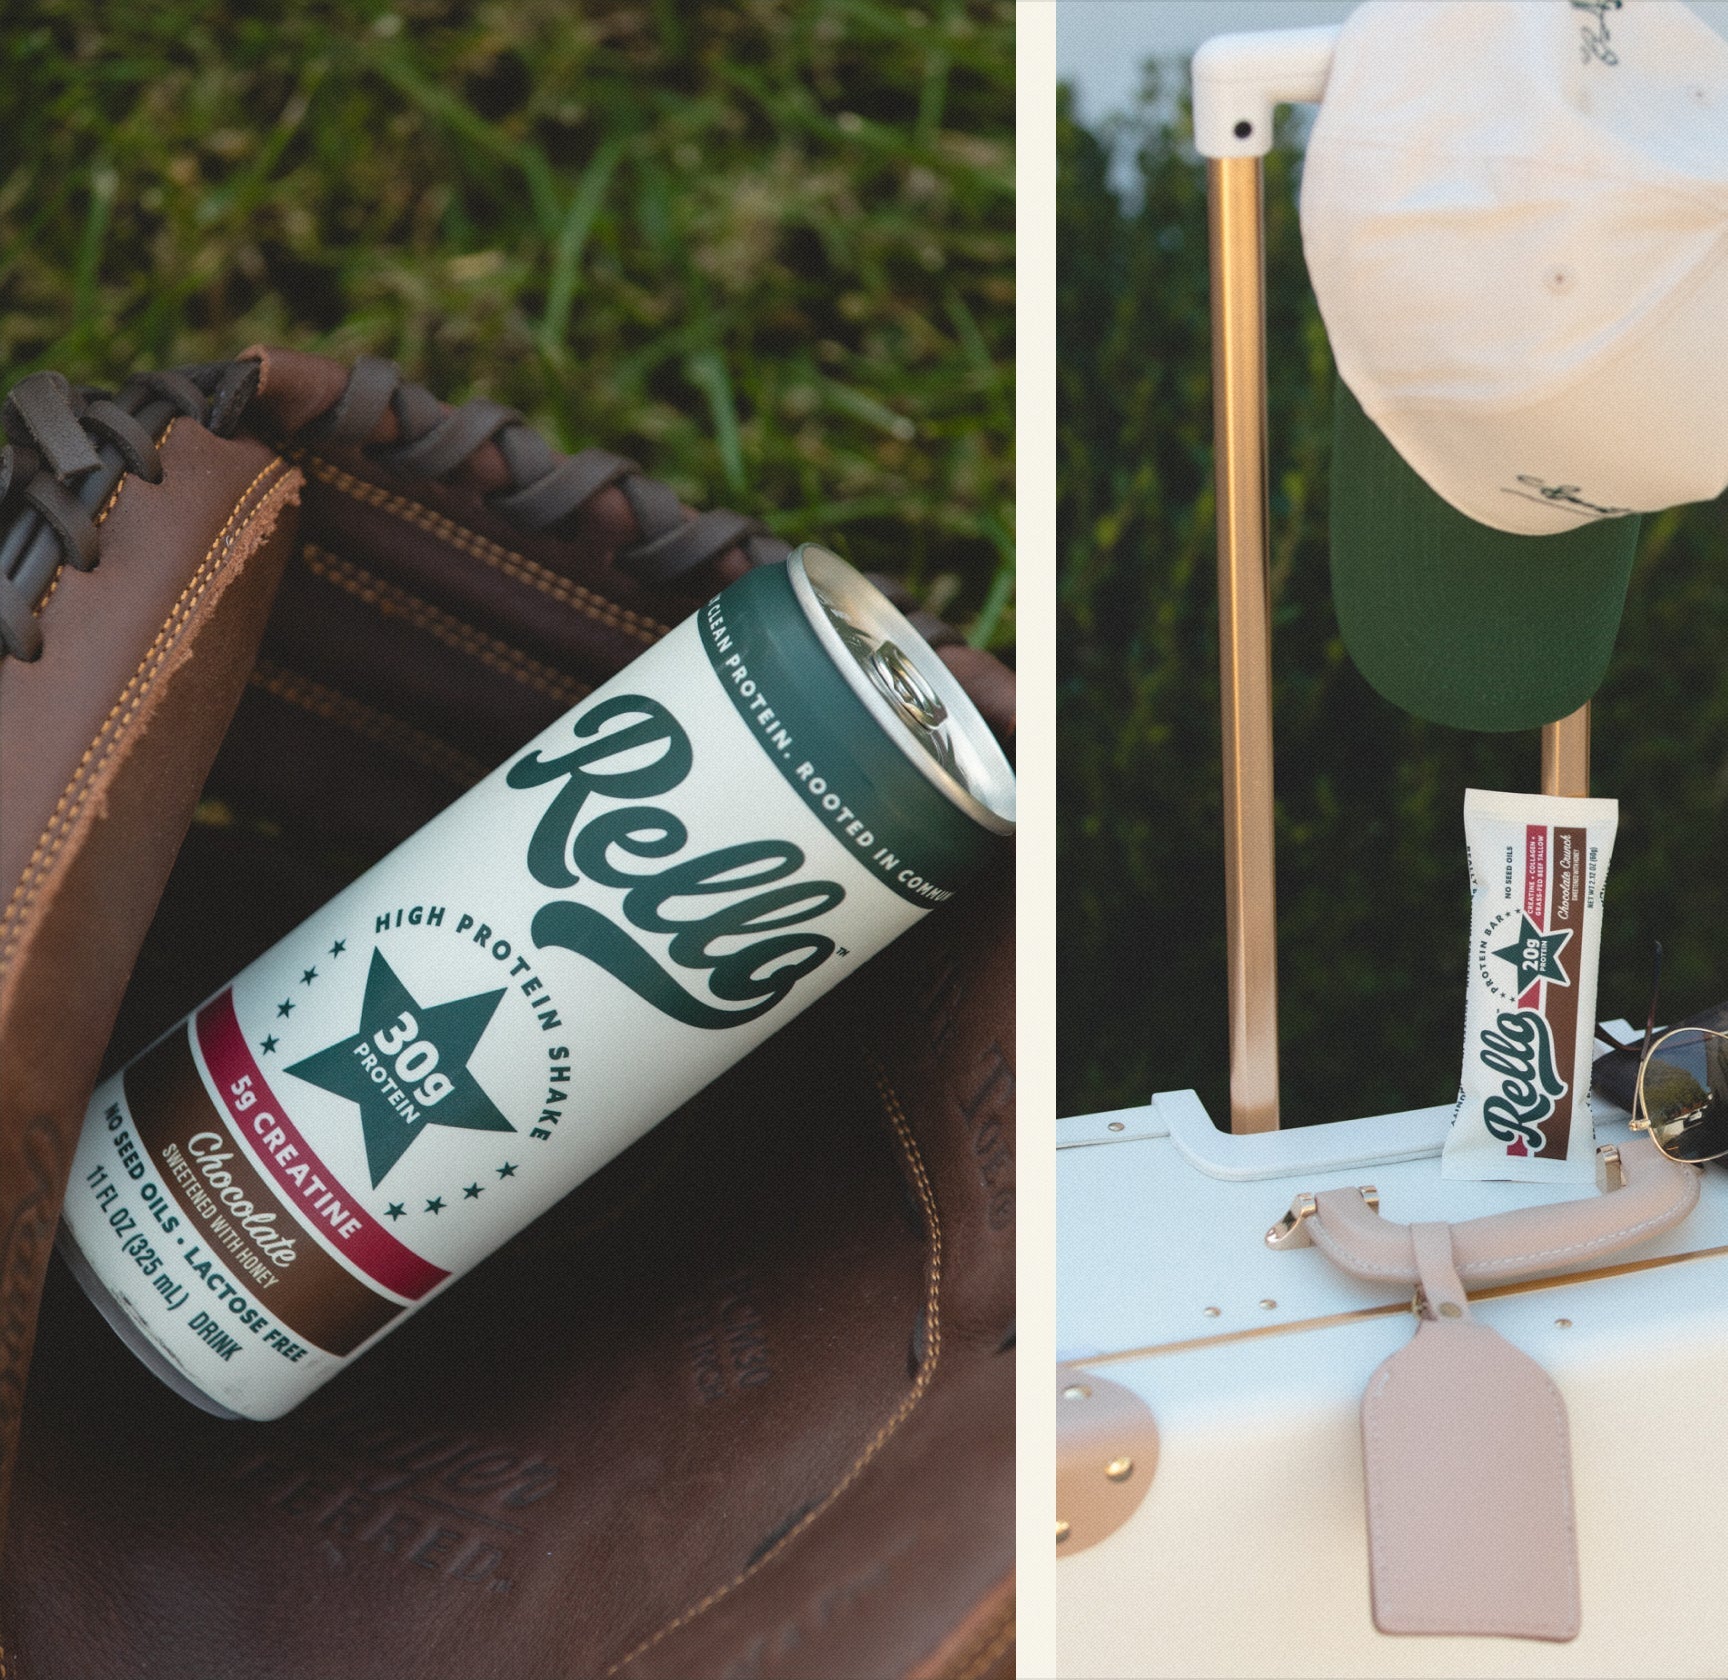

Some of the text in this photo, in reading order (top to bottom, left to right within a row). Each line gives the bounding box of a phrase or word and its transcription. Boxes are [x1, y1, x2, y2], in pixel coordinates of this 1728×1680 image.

[706, 603, 733, 653] CLEAN
[725, 653, 793, 760] PROTEIN.
[796, 761, 875, 848] ROOTED
[873, 847, 900, 871] IN
[506, 694, 847, 1030] Rello
[1505, 887, 1512, 899] NO
[1527, 841, 1536, 914] CREATINE COLLAGEN
[1536, 835, 1545, 861] TALLOW
[1557, 834, 1572, 920] Chocolate Crunch
[1535, 878, 1543, 916] GRASS-FED
[1478, 915, 1504, 994] PROTEIN BAR
[1522, 938, 1540, 972] 20g
[1539, 940, 1548, 972] PROTEIN
[373, 1010, 455, 1107] 30g
[375, 905, 571, 1141] HIGH PROTEIN SHAKE
[353, 1042, 421, 1125] PROTEIN
[1480, 1011, 1564, 1148] Rello
[187, 1132, 297, 1268] Chocolate
[230, 1075, 363, 1240] 5g CREATINE
[86, 1164, 243, 1363] 11 FL OZ (325 mL) DRINK
[104, 1101, 308, 1363] NO SEED OILS LACTOSE FREE
[161, 1142, 280, 1290] SWEETENED WITH HONEY
